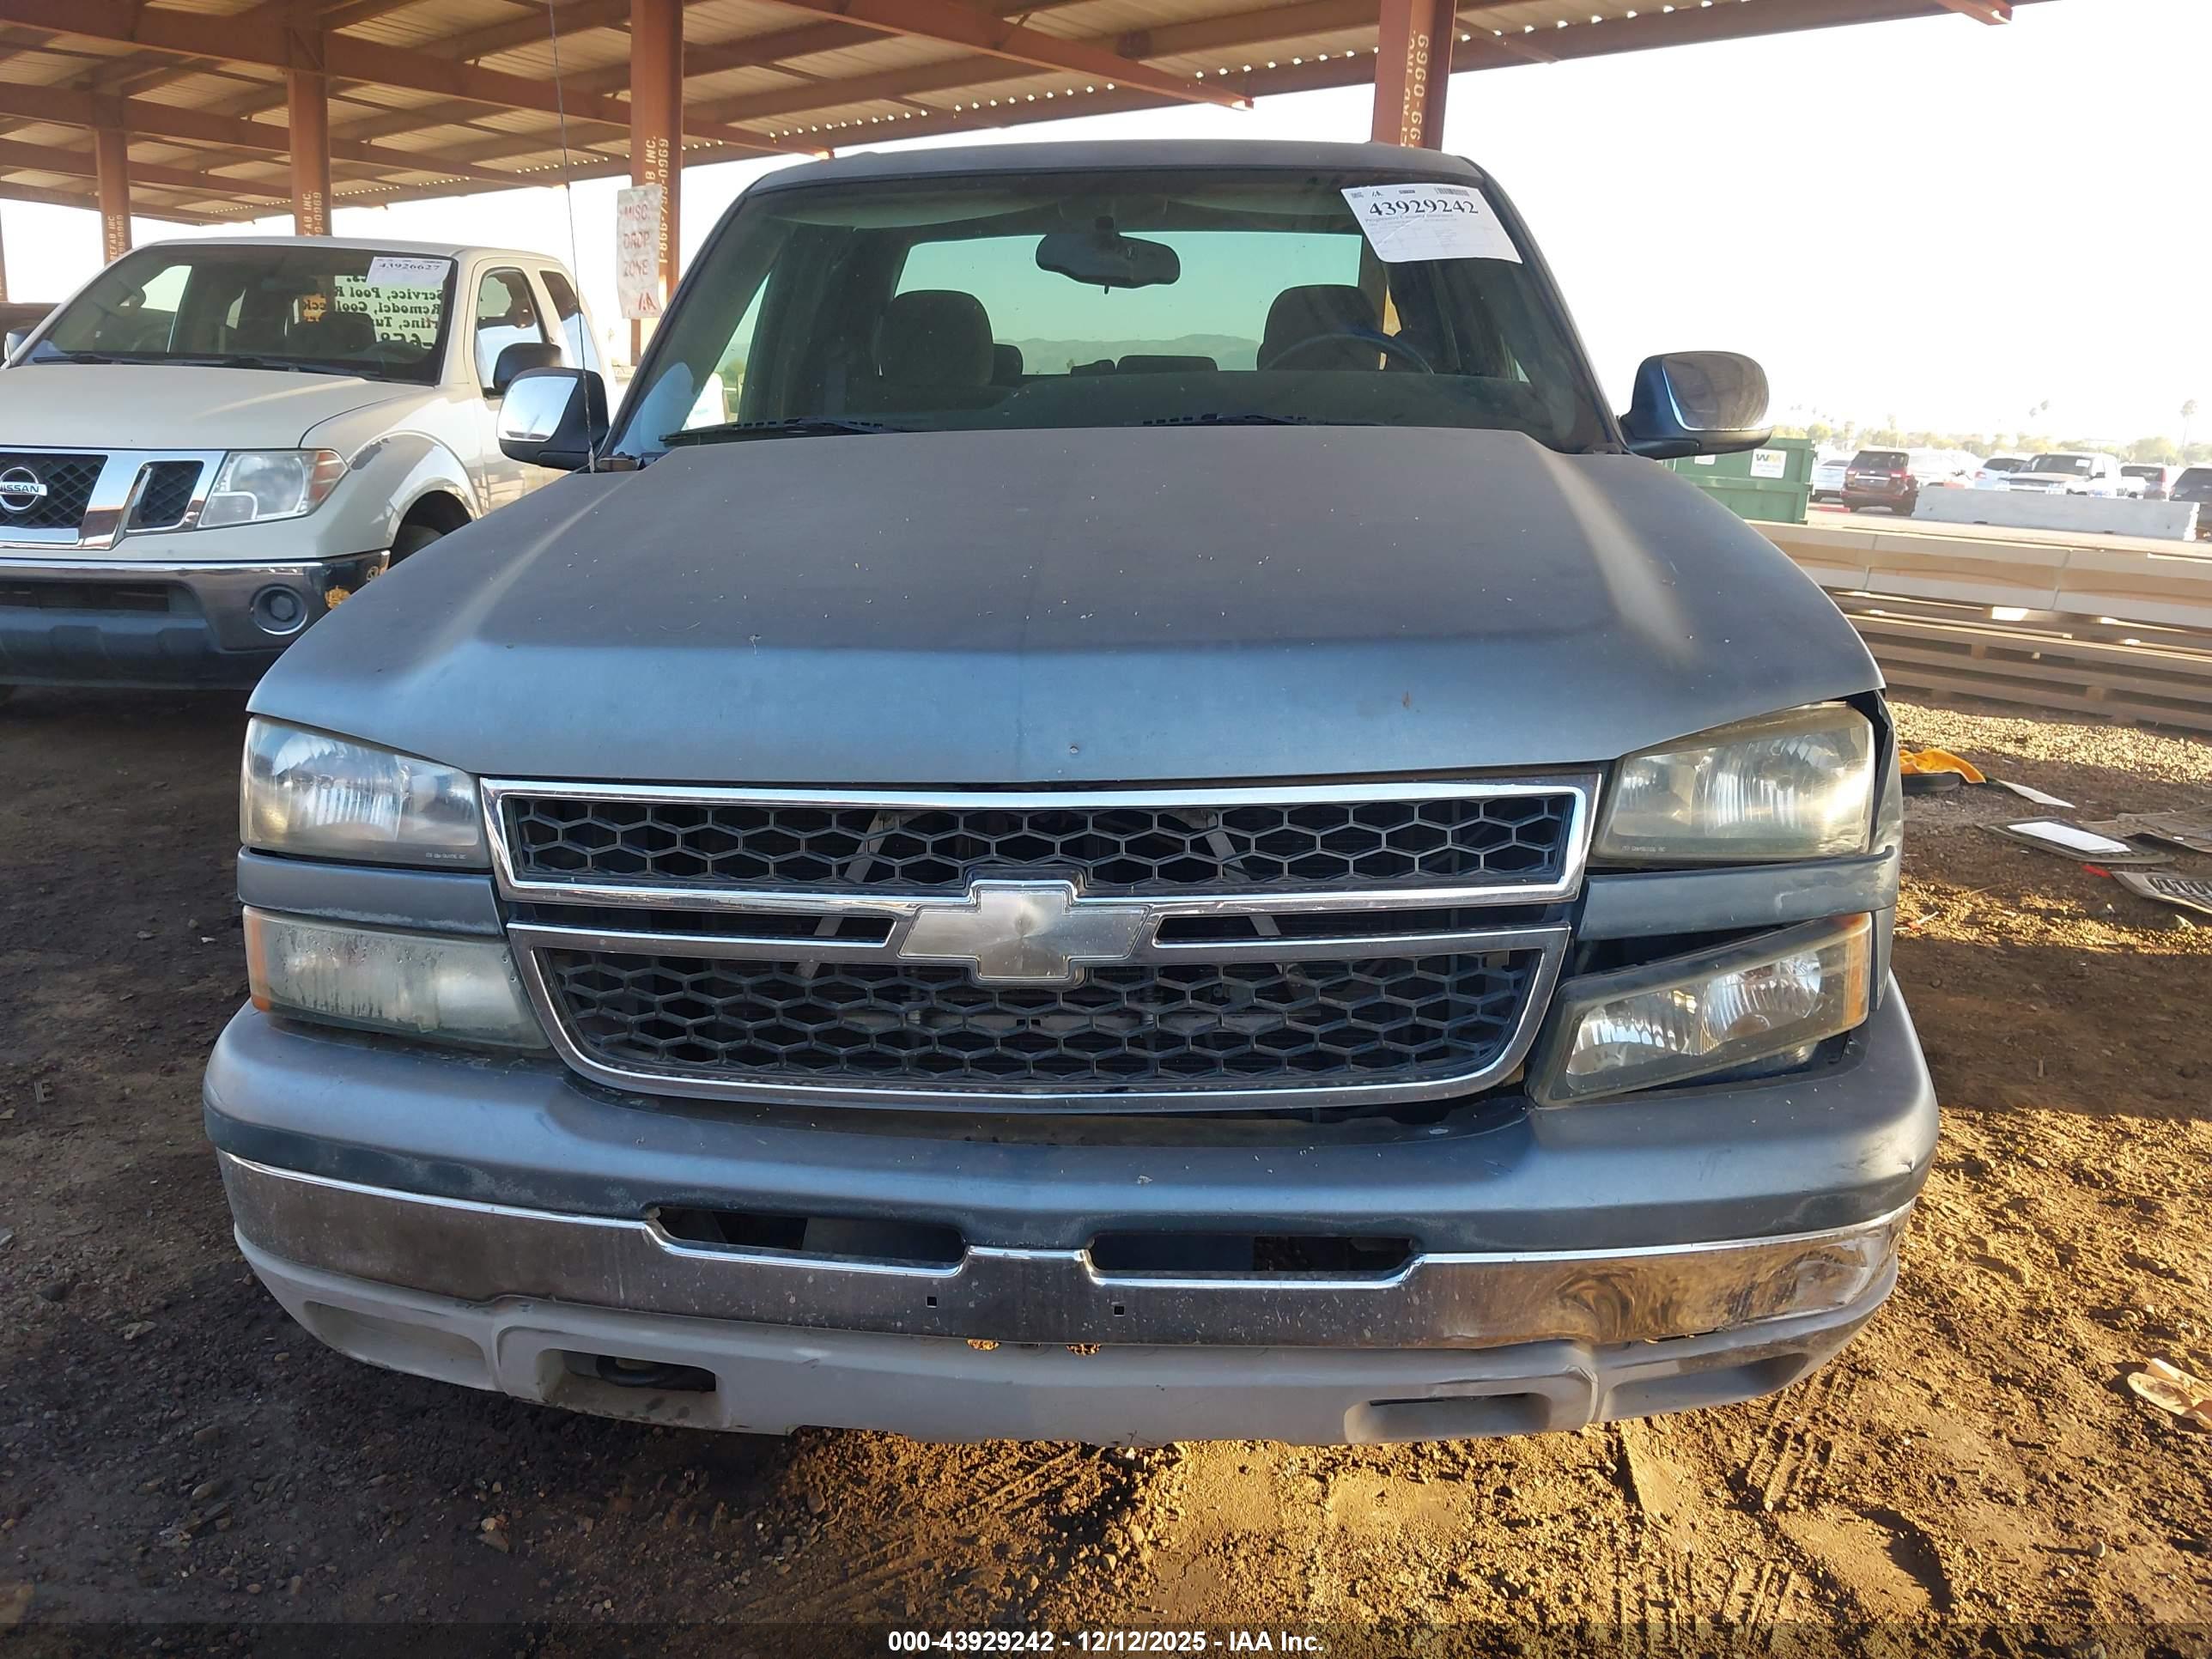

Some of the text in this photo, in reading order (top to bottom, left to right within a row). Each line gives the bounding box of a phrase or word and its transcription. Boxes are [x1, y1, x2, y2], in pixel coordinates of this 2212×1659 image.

[645, 136, 656, 164] INC.
[1369, 199, 1479, 216] 43929242
[623, 231, 650, 249] DROP
[623, 259, 648, 277] ZONE
